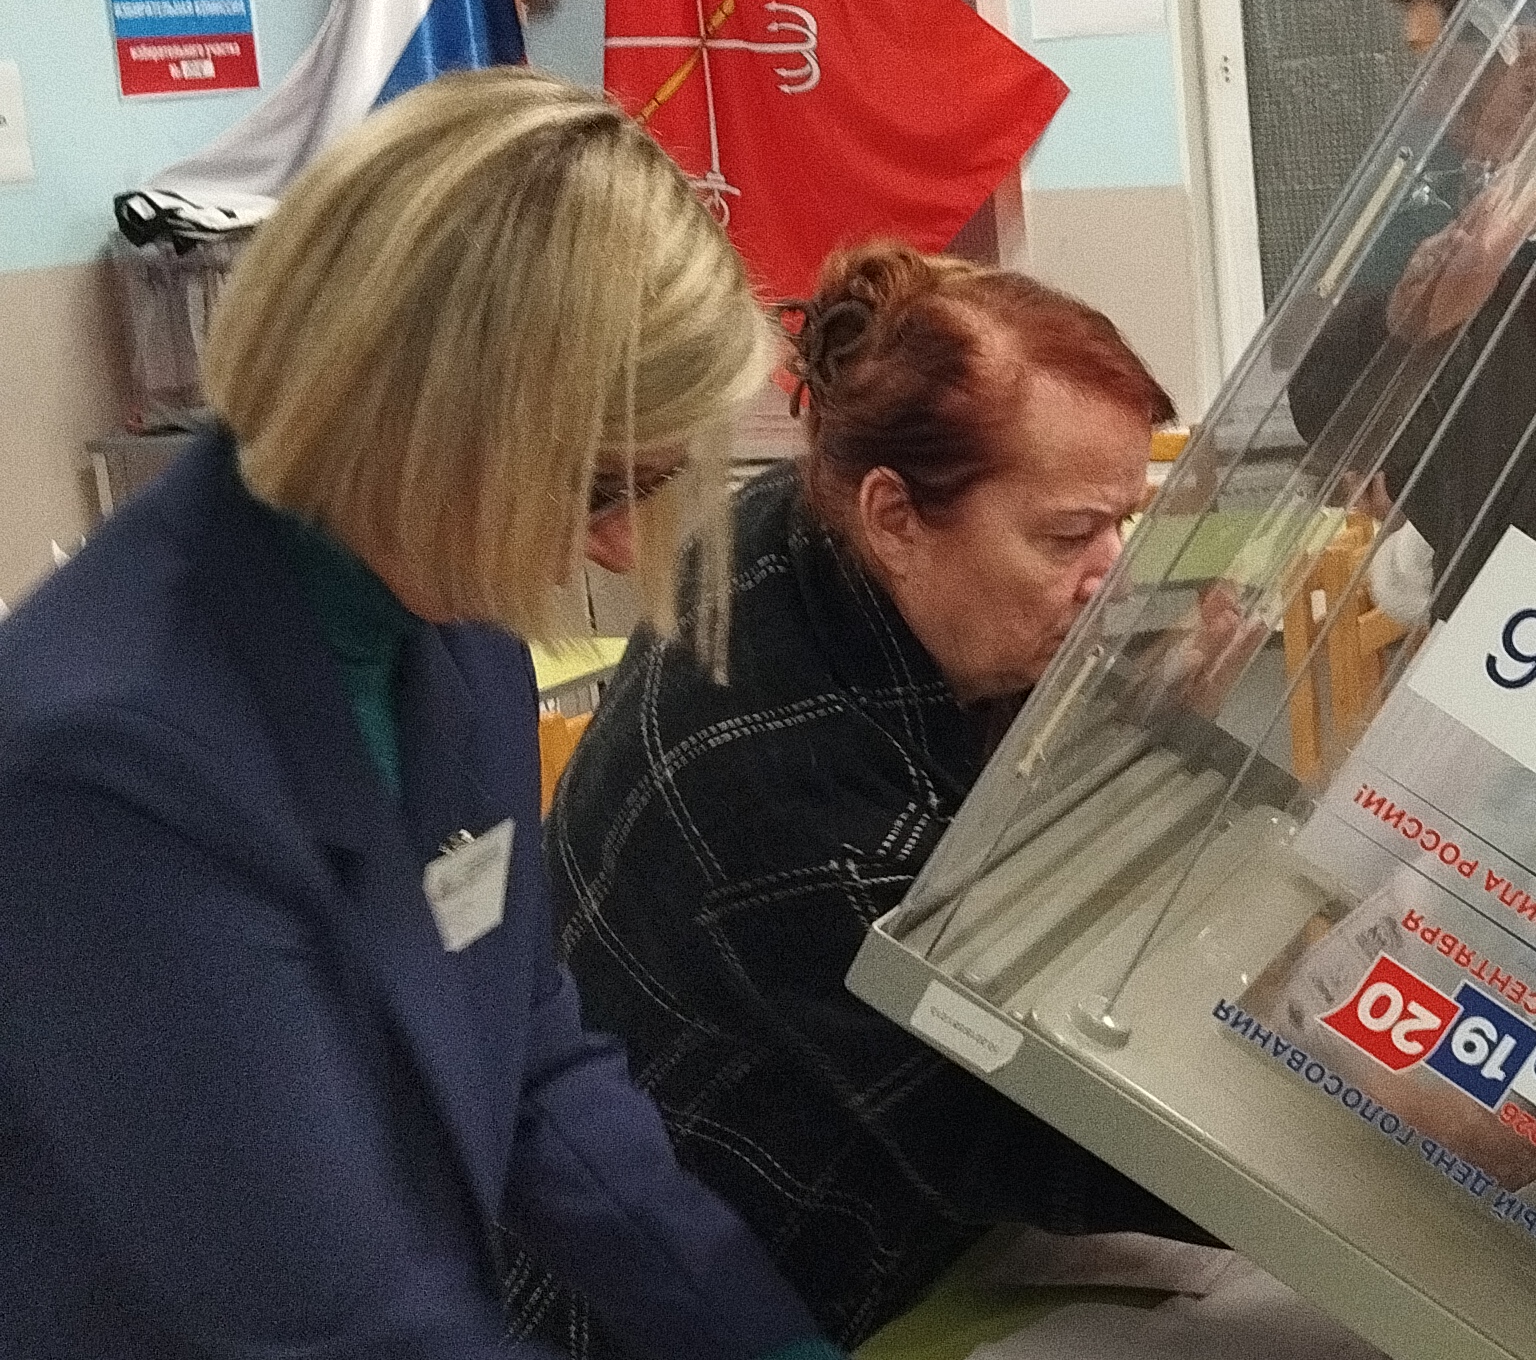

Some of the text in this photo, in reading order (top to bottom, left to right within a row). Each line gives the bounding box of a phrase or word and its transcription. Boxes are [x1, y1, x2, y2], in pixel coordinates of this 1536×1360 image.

[1353, 783, 1479, 879] РОССИИ!
[1356, 981, 1443, 1056] 20
[1450, 1016, 1518, 1083] 19
[1211, 998, 1418, 1147] ГОЛОСОВАНИЯ
[1420, 1138, 1497, 1198] ДЕНЬ
